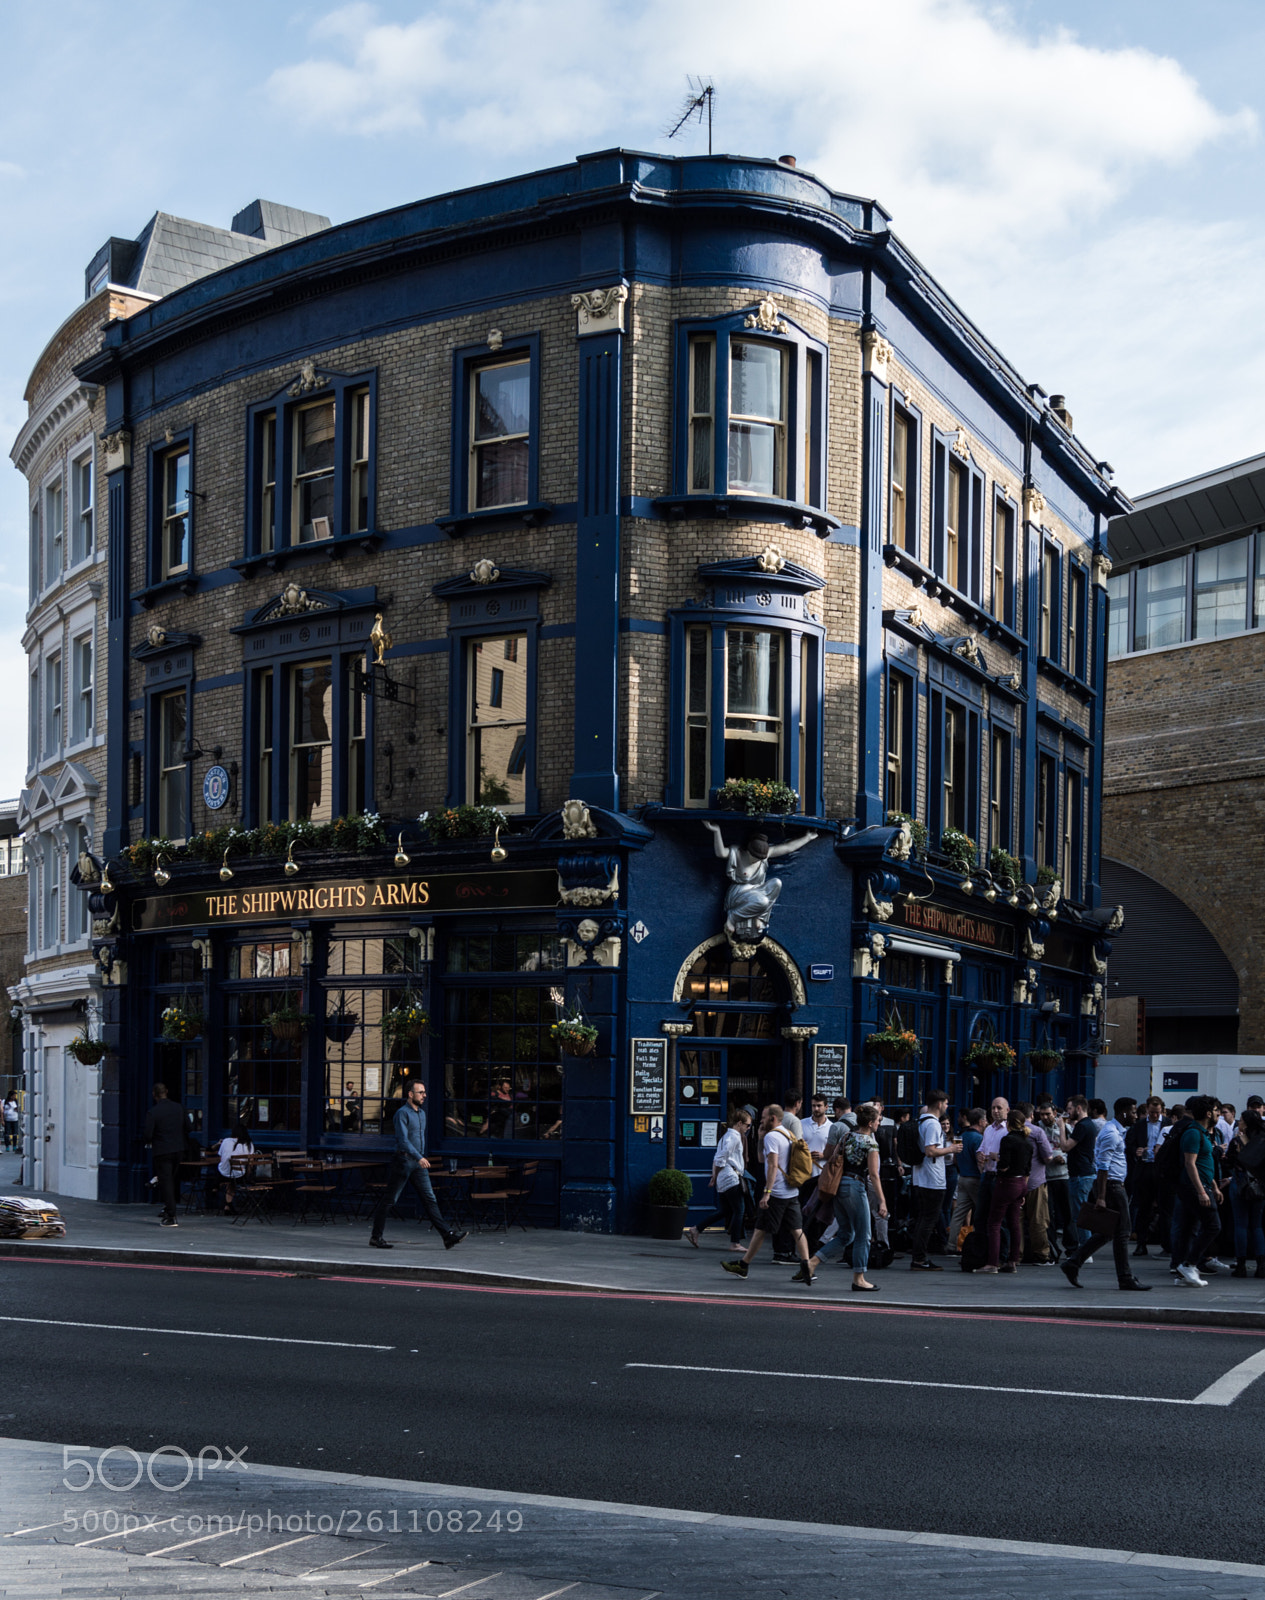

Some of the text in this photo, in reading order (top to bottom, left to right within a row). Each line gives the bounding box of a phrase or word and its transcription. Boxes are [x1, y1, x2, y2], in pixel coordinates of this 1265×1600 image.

[205, 881, 430, 917] THE SHIPWRIGHTS ARMS
[905, 904, 996, 945] THE SHIPWRIGHTS ARMS
